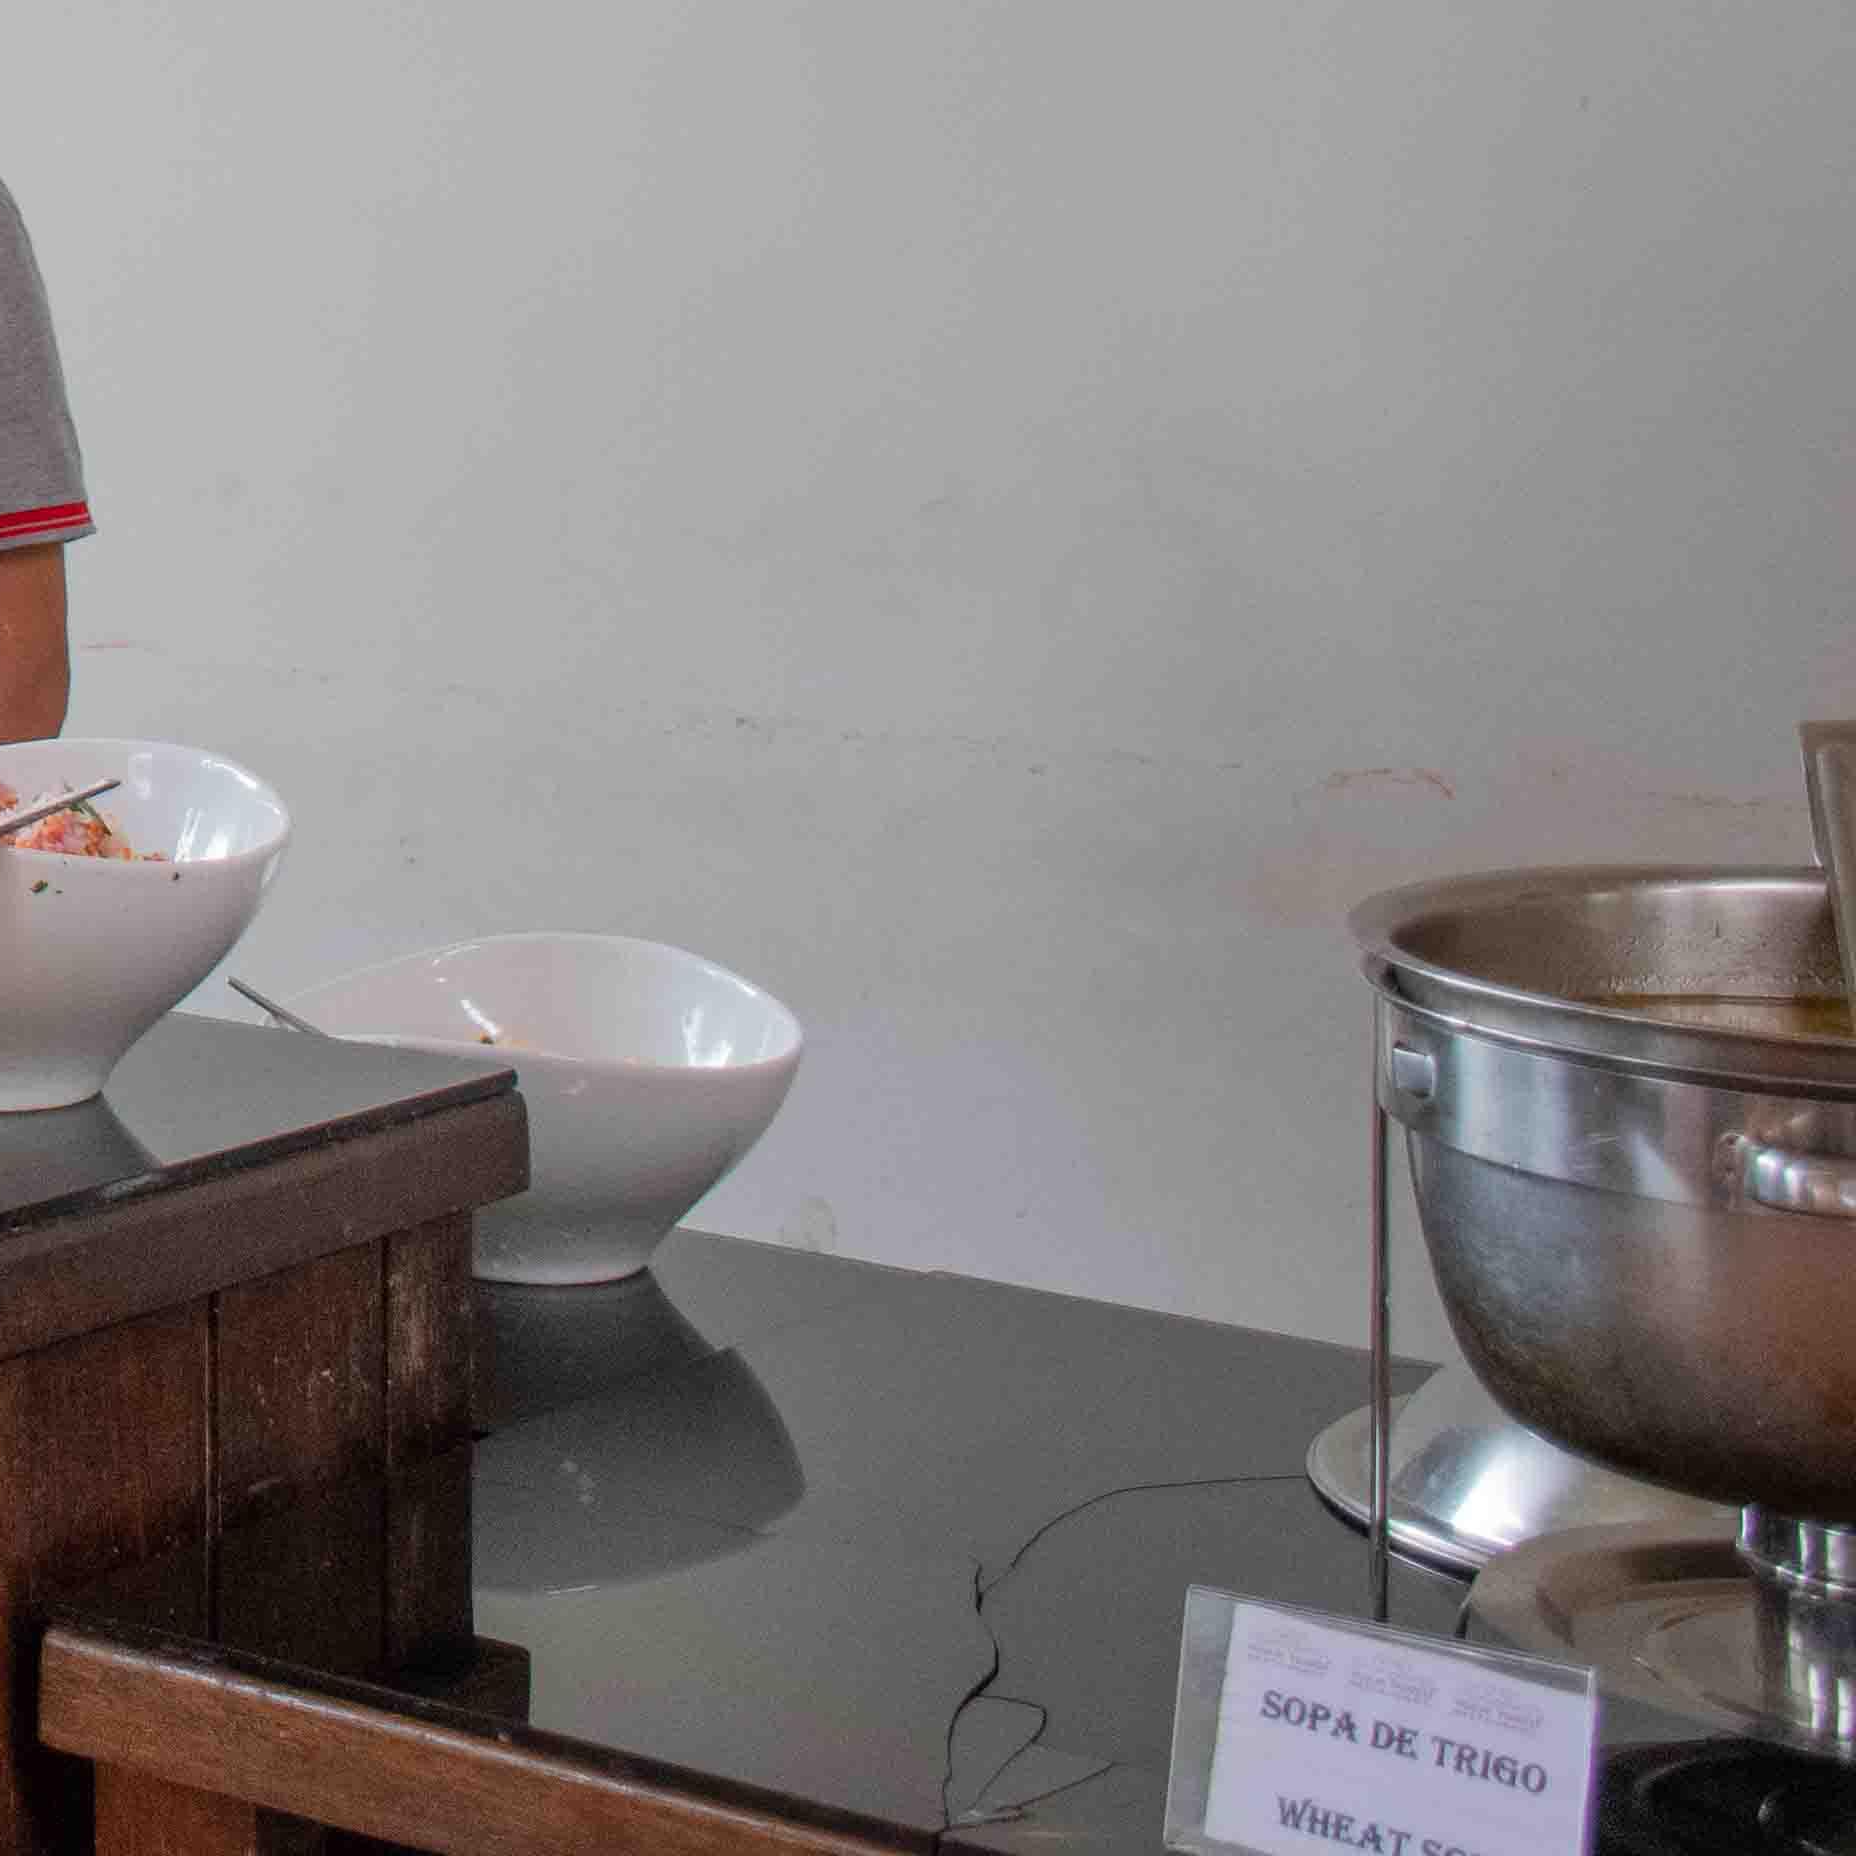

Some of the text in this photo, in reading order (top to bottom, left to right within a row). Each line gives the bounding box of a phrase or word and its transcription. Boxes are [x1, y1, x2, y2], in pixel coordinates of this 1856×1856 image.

[1260, 1689, 1548, 1795] SOPA DE TRIGO
[1276, 1794, 1411, 1856] WHEAT
